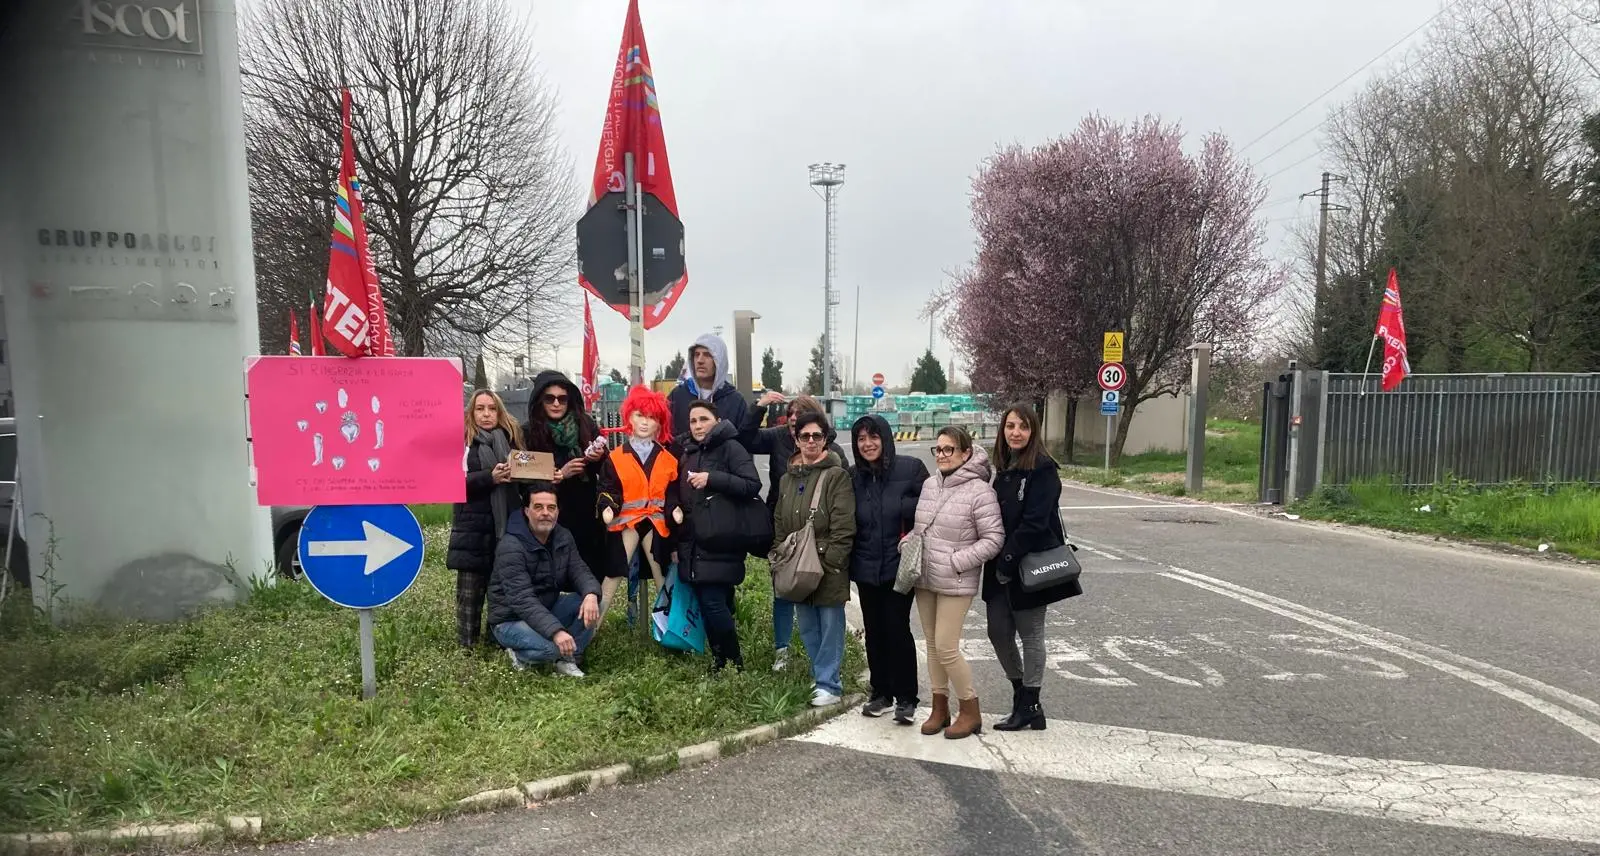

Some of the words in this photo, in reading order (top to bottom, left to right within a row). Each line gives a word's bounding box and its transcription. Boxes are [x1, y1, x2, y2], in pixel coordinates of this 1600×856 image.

[613, 48, 624, 97] ZIONE
[288, 363, 303, 376] SI
[1104, 370, 1120, 383] 30
[1030, 560, 1069, 576] VALENTINO
